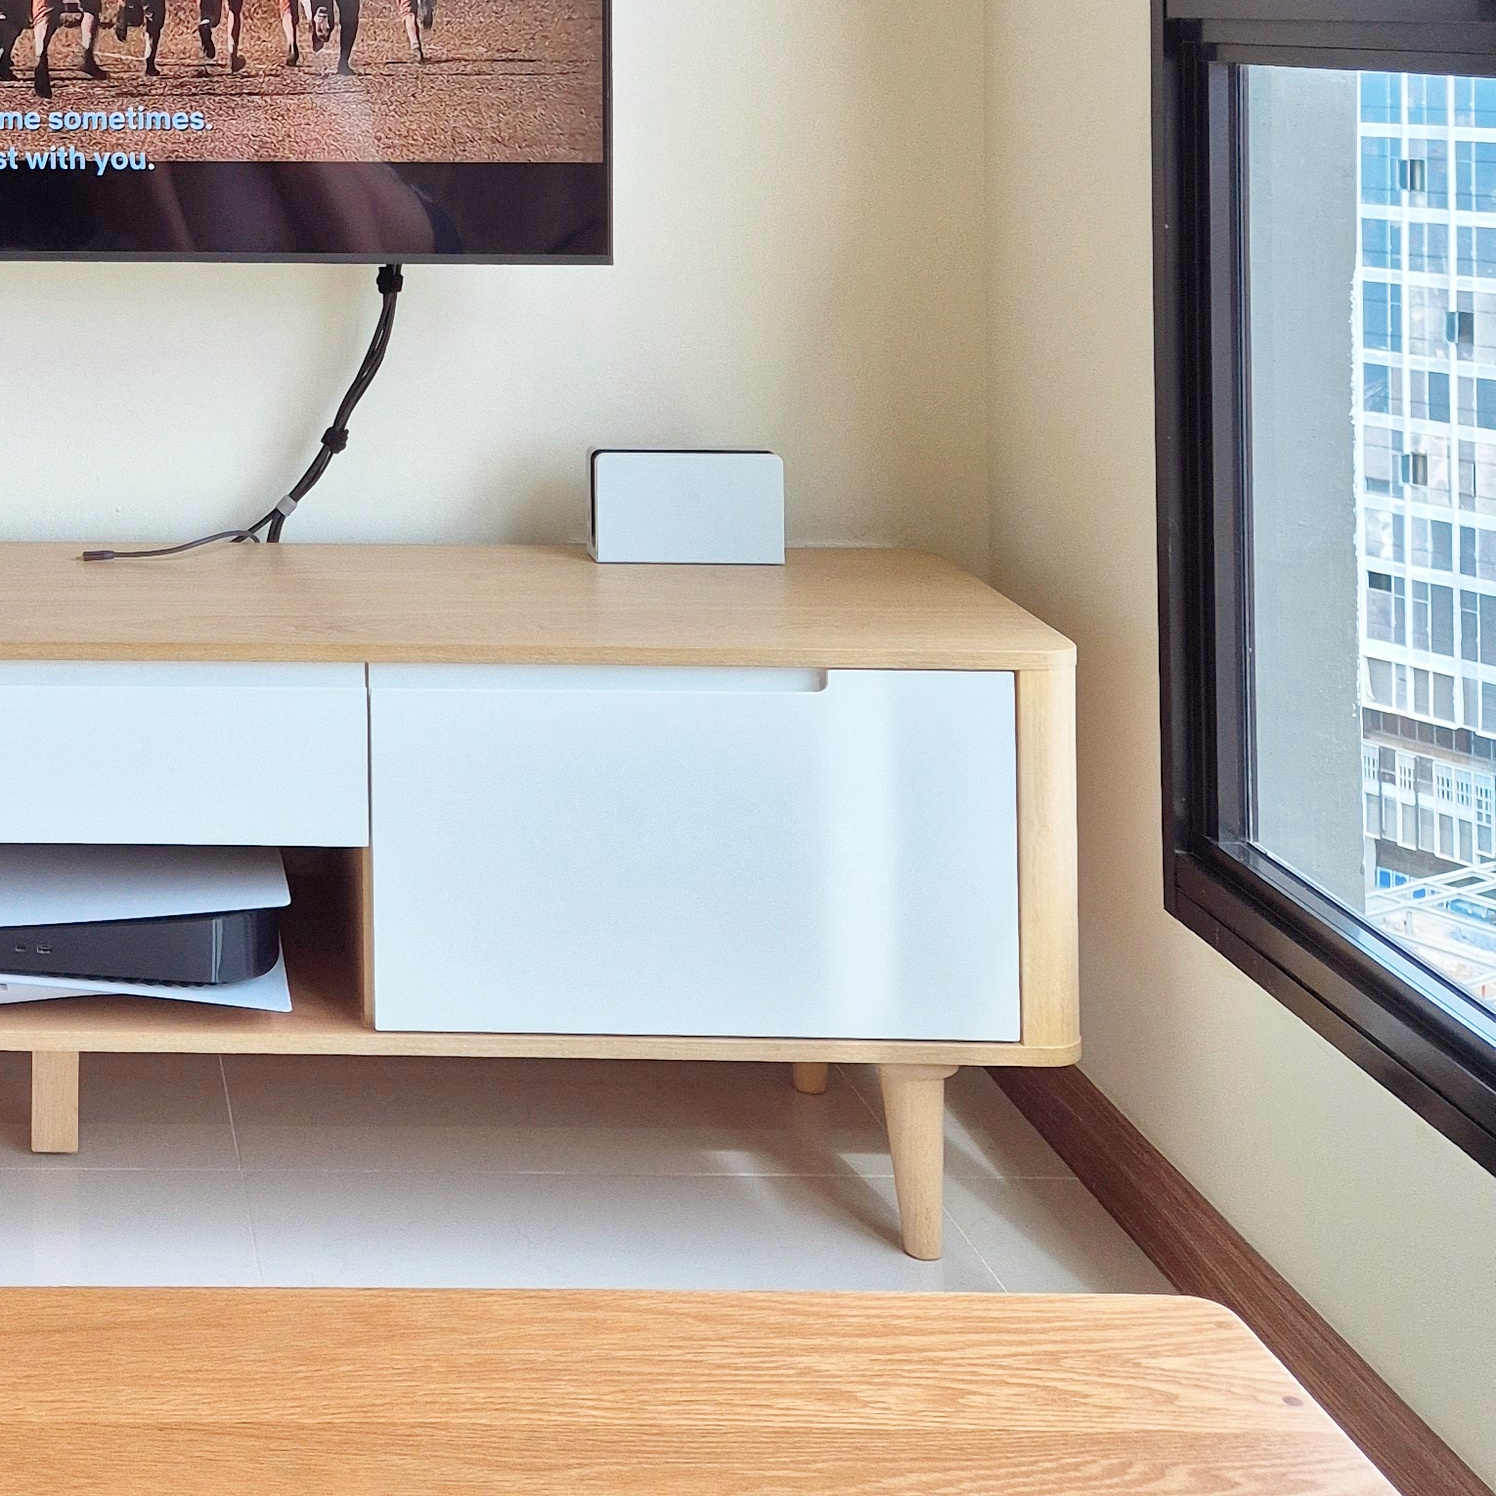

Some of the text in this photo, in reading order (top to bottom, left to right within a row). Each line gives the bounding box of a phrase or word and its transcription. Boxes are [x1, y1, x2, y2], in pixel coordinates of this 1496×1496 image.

[48, 106, 213, 130] sometimes.
[25, 146, 86, 170] with
[93, 151, 156, 176] you.
